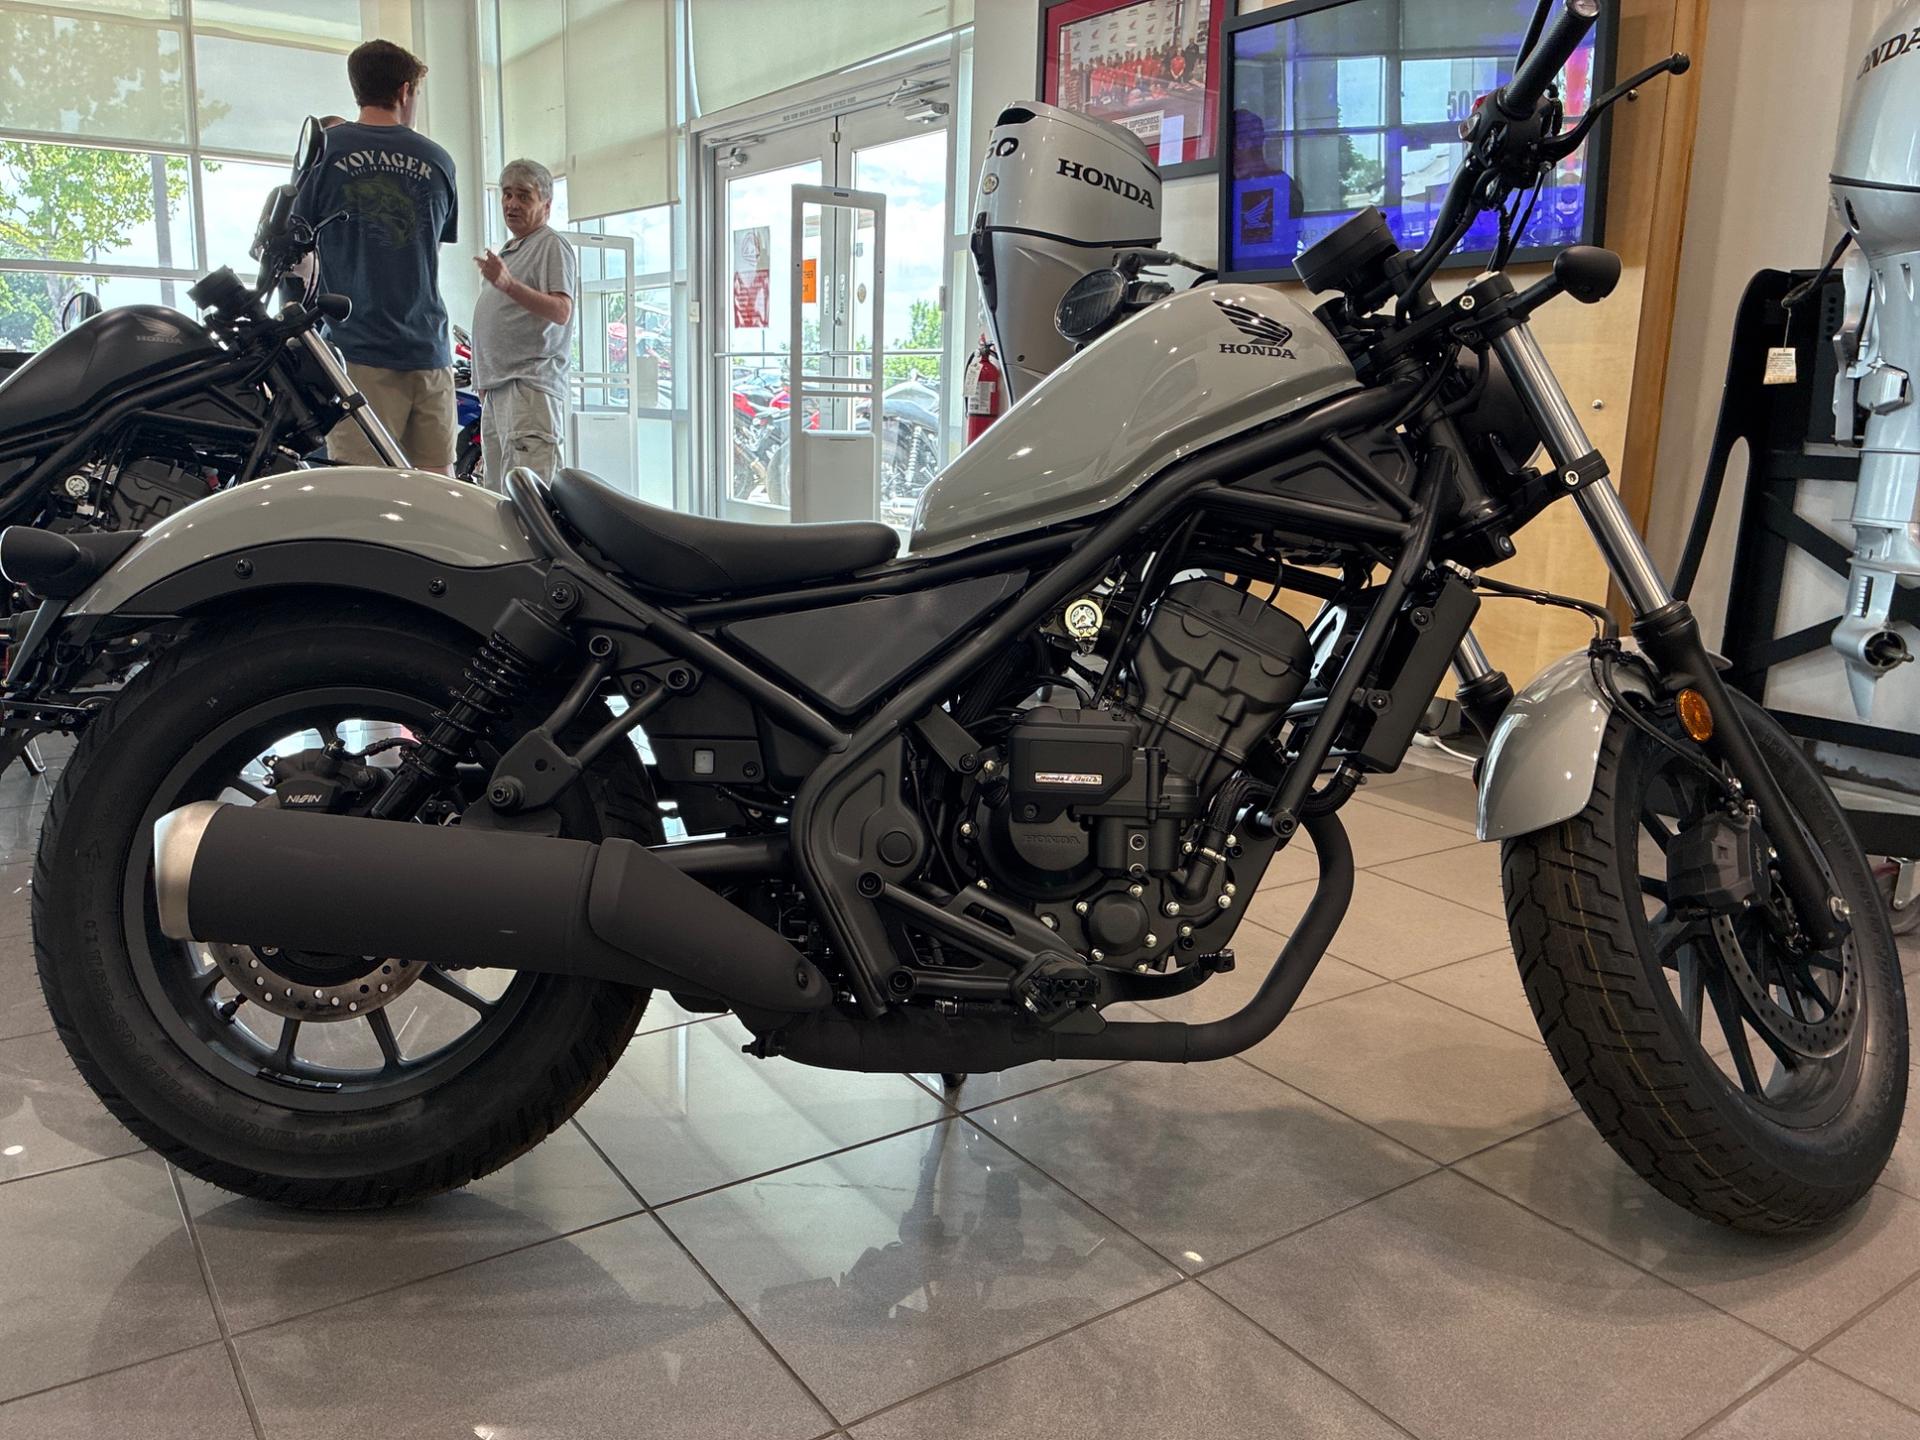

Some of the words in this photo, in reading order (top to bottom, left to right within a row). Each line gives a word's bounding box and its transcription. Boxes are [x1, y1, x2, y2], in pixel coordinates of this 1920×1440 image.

[334, 150, 432, 180] VOYAGER
[1056, 157, 1155, 210] HONDA
[136, 335, 183, 345] HONDA
[1219, 343, 1296, 359] HONDA
[1023, 834, 1081, 845] HONDA
